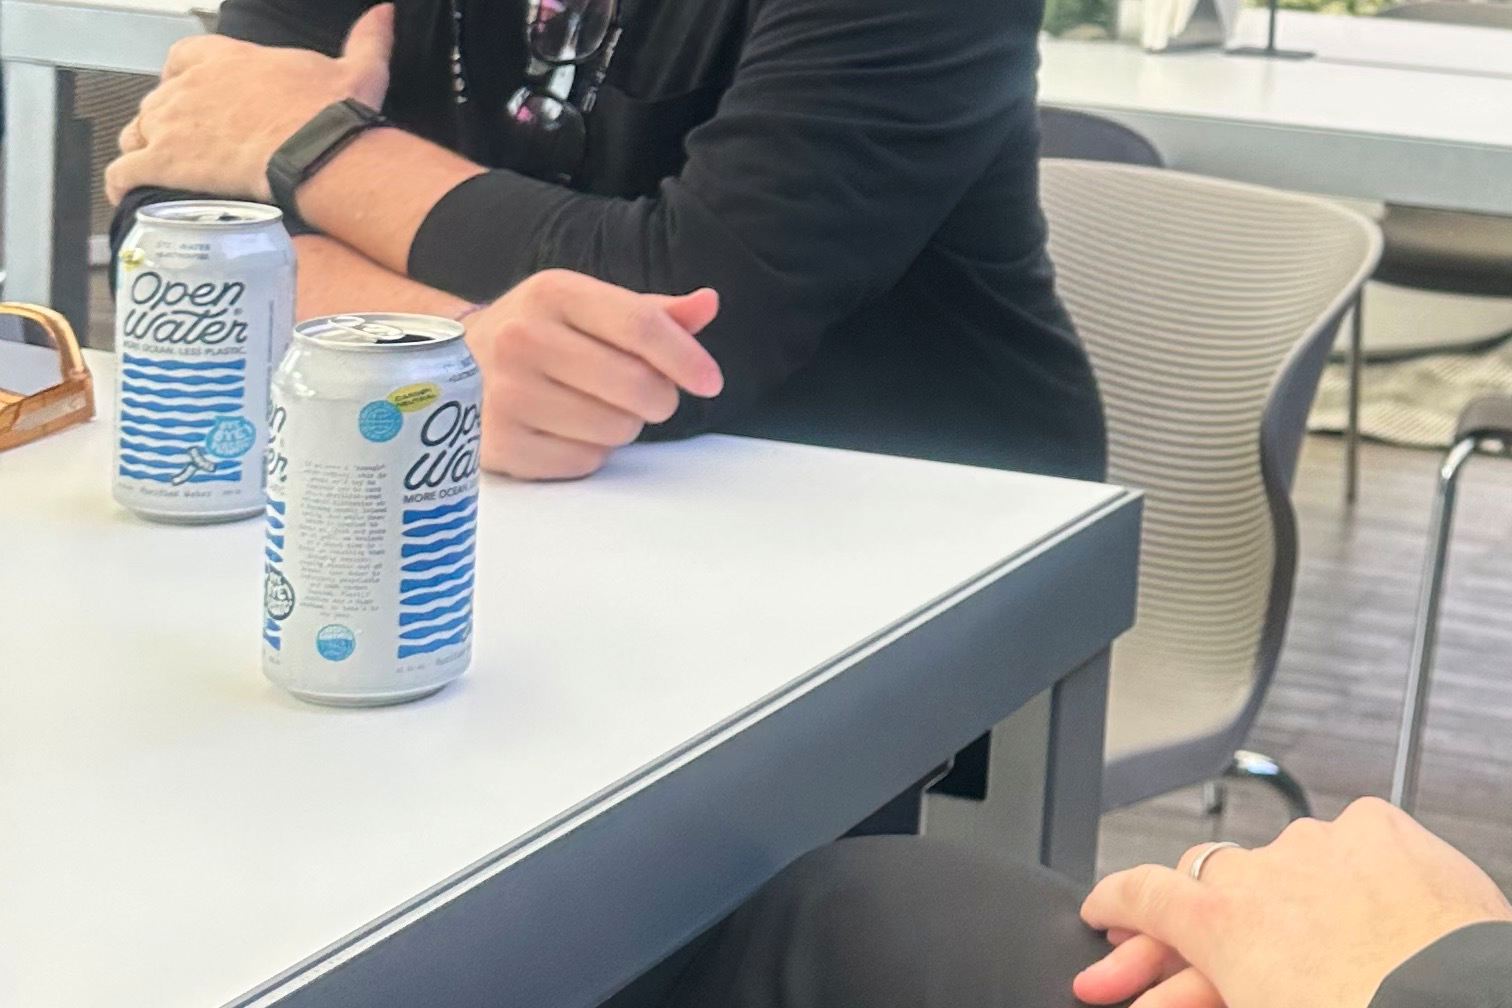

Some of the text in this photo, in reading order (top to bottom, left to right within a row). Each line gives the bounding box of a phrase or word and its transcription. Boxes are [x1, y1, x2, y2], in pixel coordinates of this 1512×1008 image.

[131, 271, 246, 310] Open
[123, 307, 249, 345] Water
[420, 400, 480, 448] Op
[403, 491, 437, 503] MORE
